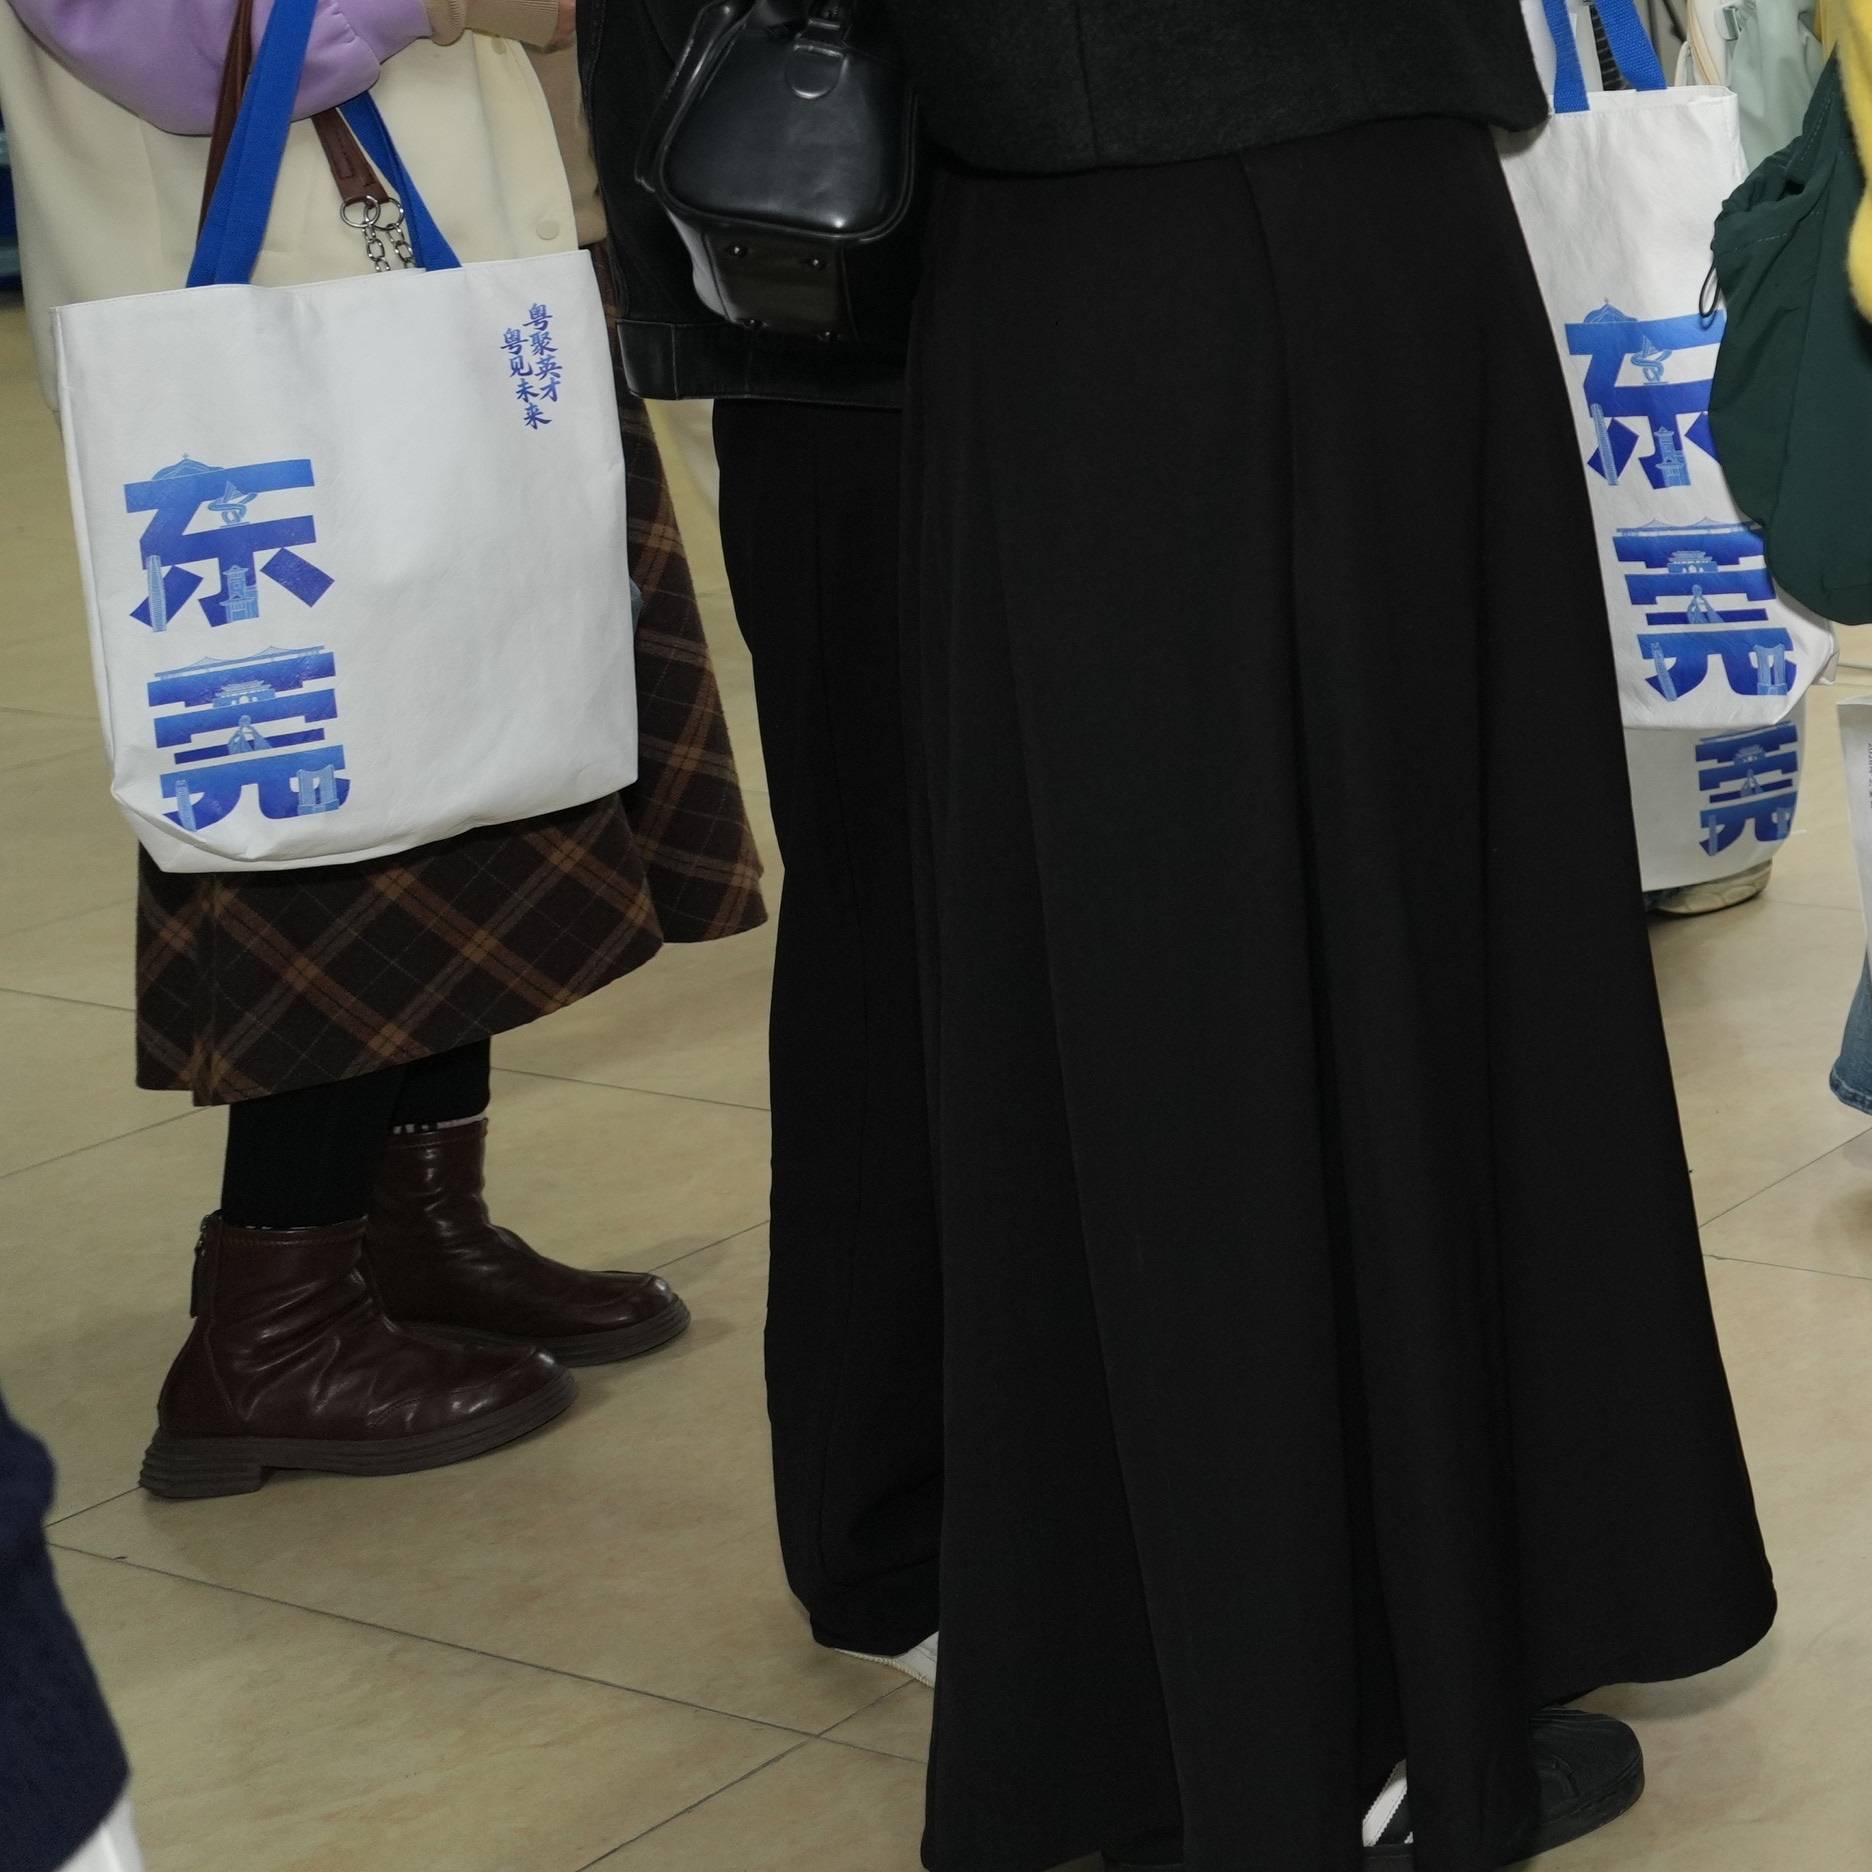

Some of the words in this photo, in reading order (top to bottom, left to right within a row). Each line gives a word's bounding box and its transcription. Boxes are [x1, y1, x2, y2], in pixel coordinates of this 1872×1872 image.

[500, 327, 553, 430] 粤见未来
[522, 302, 563, 403] 粤聚英才
[1564, 299, 1798, 705] 东莞
[123, 453, 353, 832] 东莞
